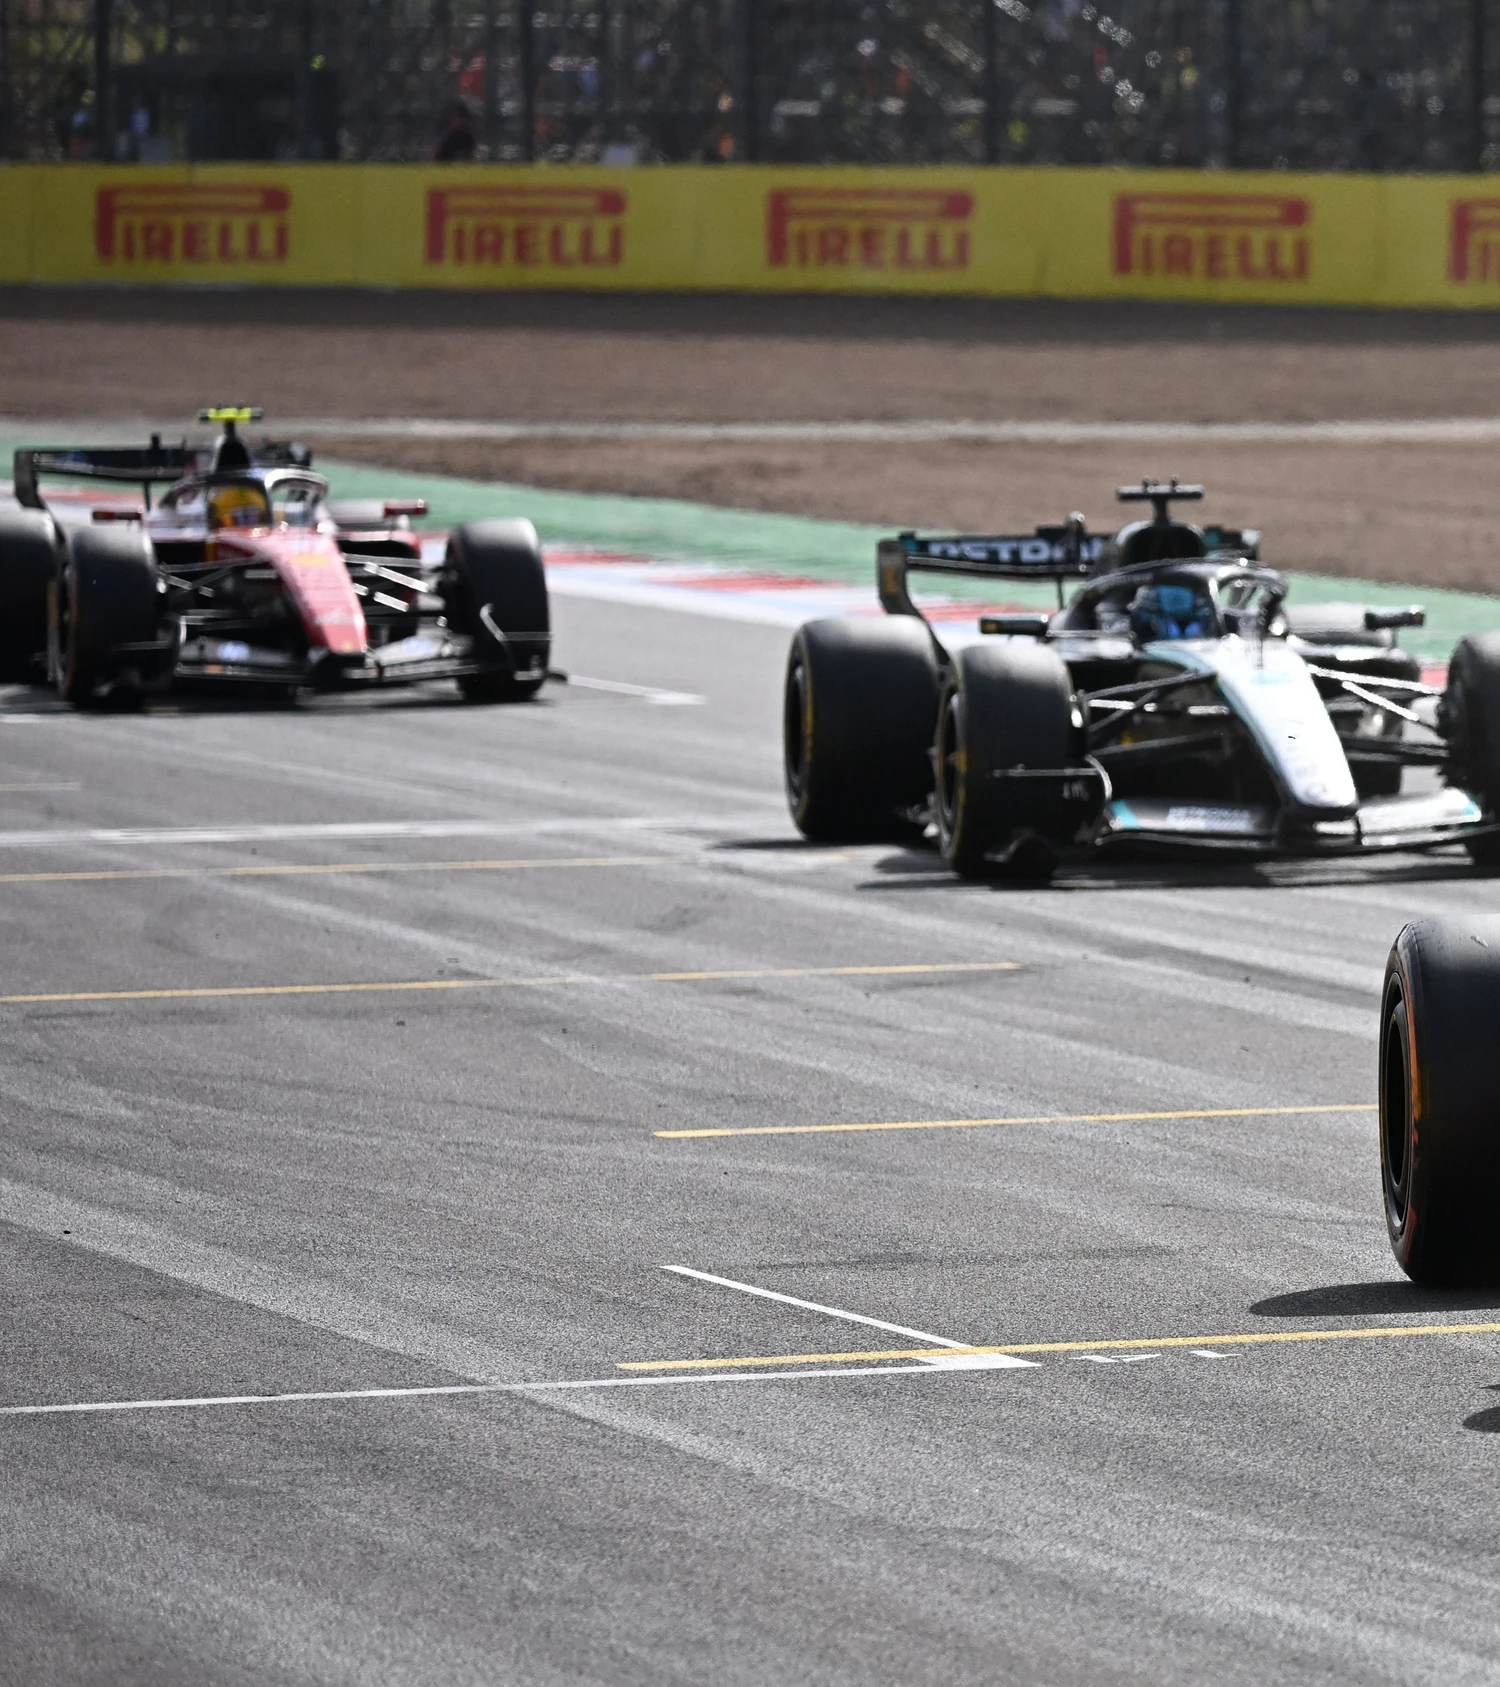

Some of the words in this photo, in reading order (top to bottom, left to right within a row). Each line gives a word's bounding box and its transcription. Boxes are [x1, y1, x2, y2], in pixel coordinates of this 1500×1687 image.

[97, 186, 289, 262] PIRELLI
[425, 187, 626, 264] PIRELLI
[767, 189, 973, 267] PIRELLI
[1114, 194, 1311, 278] PIRELLI
